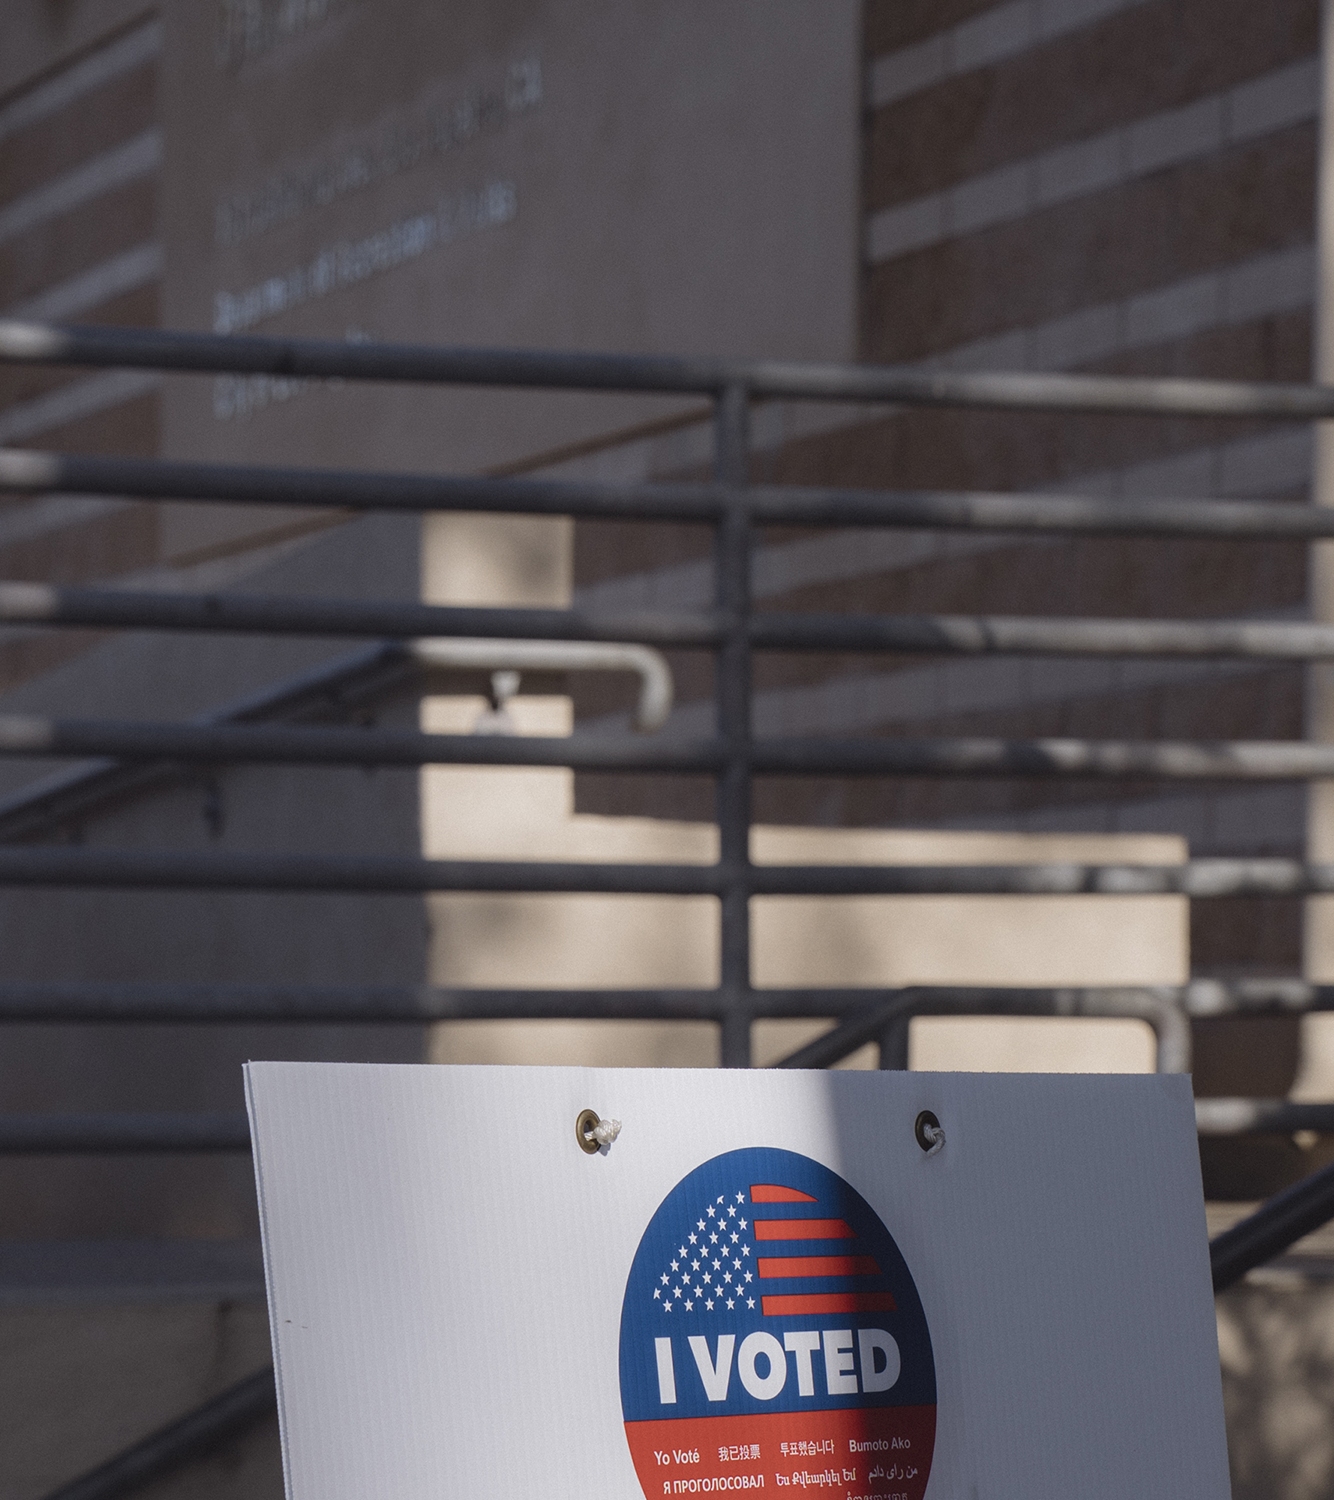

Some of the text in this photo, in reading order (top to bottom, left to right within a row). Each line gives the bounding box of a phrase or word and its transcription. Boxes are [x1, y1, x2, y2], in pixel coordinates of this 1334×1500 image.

[654, 1328, 902, 1404] I VOTED
[718, 1443, 761, 1462] 我已投票
[780, 1438, 835, 1458] 투표했습니다
[849, 1436, 911, 1453] Bumoto Ako
[654, 1447, 700, 1466] Yo Voté
[868, 1463, 885, 1485] دادم
[906, 1465, 918, 1479] من
[663, 1474, 765, 1495] Я ПРОГОЛОСОВАЛ
